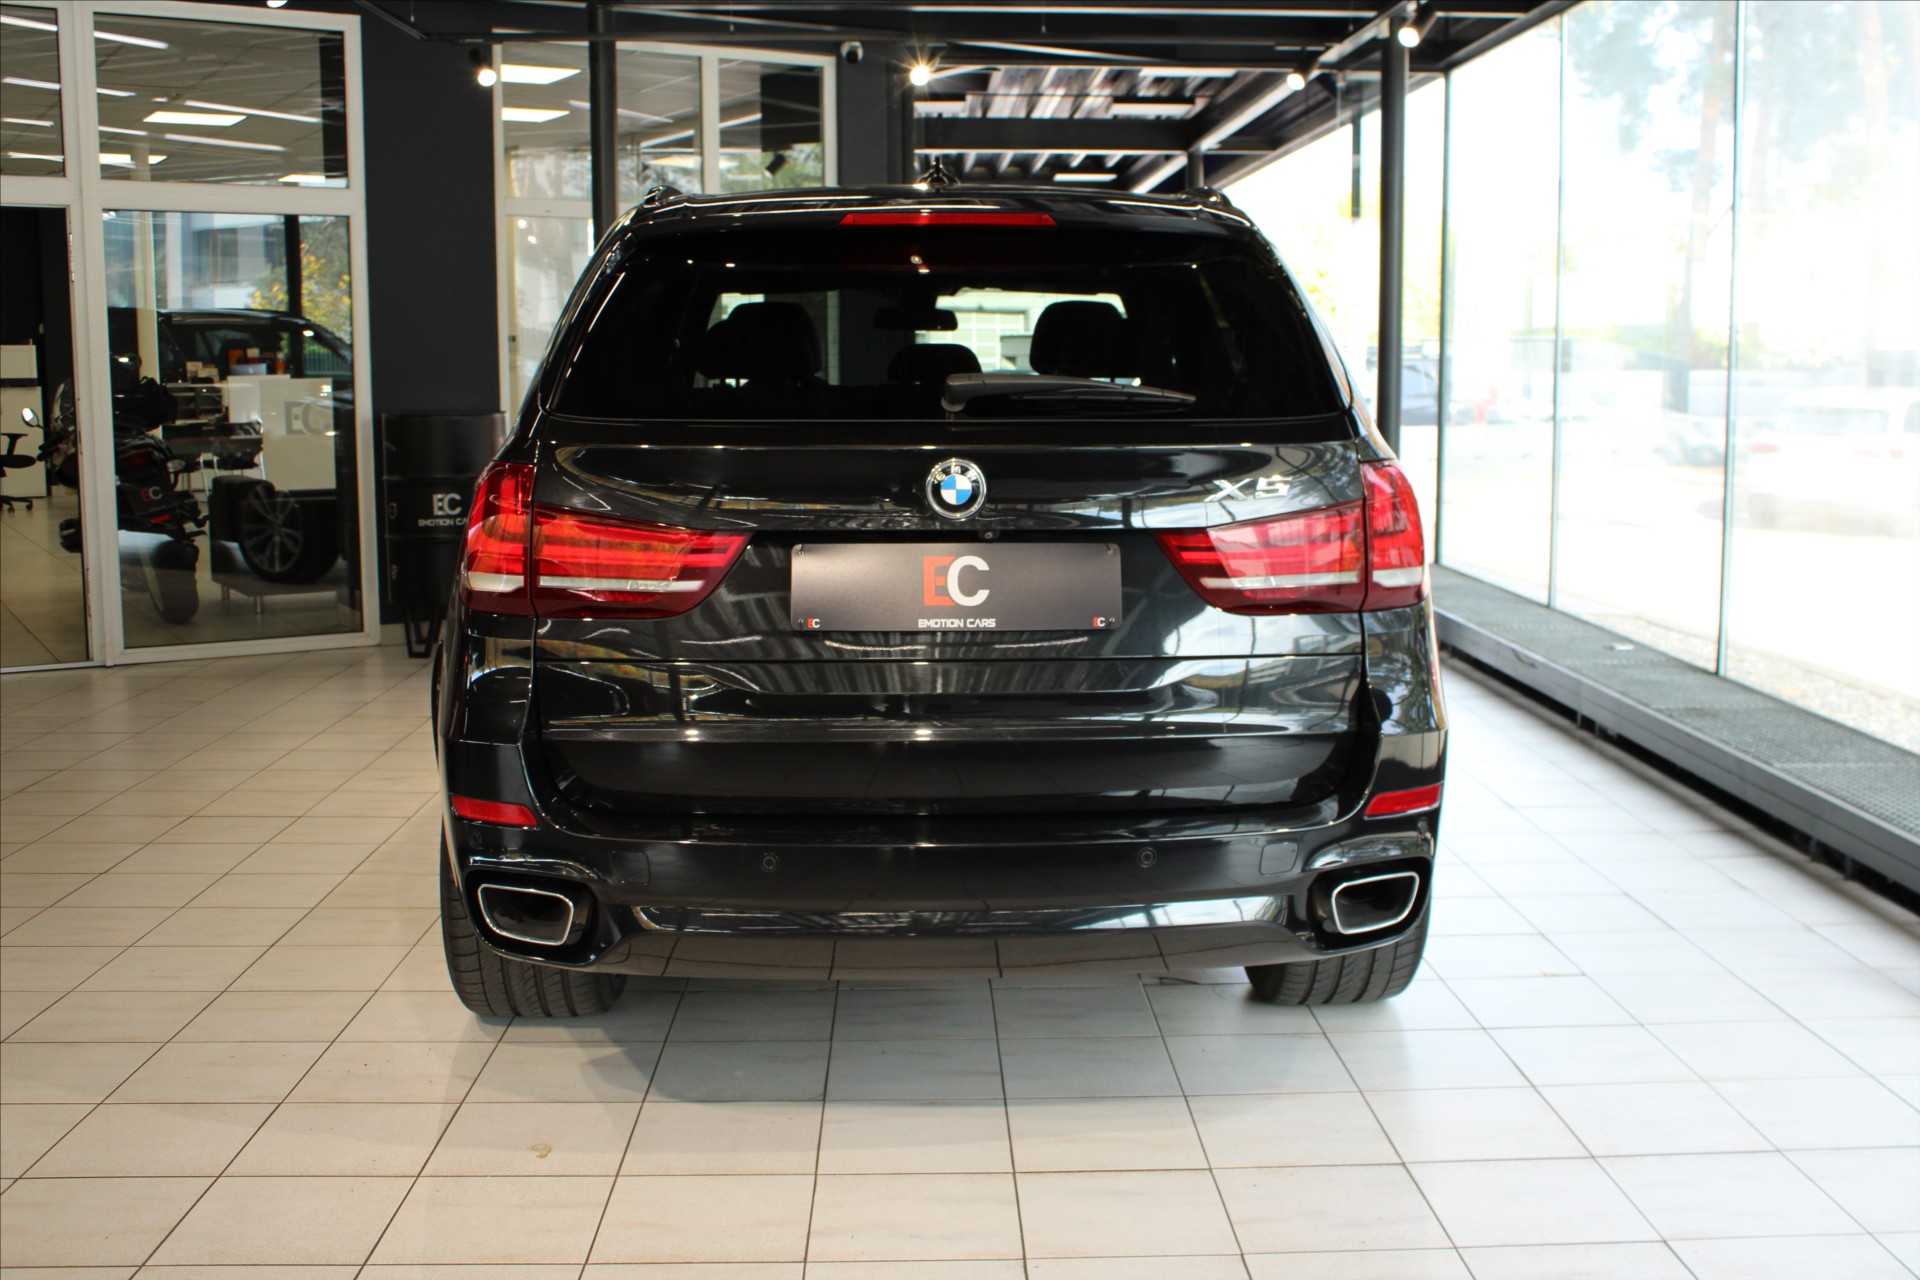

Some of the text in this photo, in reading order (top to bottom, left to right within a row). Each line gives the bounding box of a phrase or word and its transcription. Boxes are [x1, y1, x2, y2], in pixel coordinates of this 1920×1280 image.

[1203, 475, 1293, 502] X5
[432, 493, 462, 516] EC
[455, 517, 468, 526] CA
[923, 555, 990, 607] EC
[807, 617, 820, 629] EC
[918, 618, 996, 628] EMOTION CARS
[1093, 616, 1106, 628] EC
